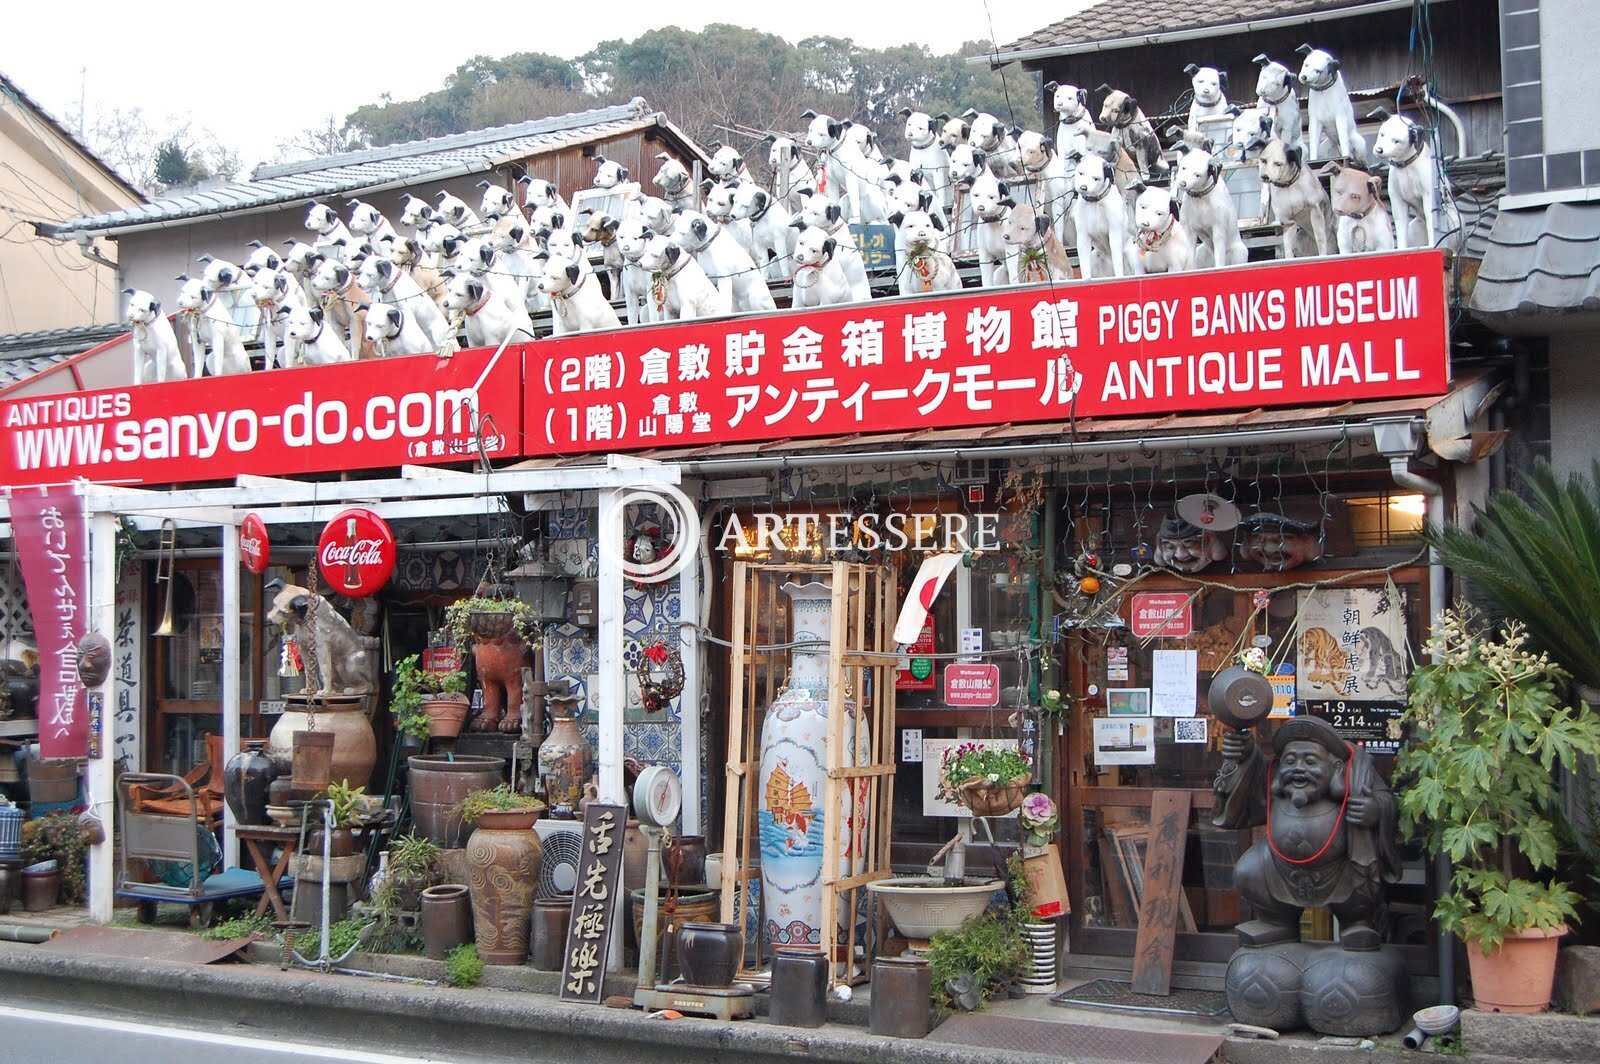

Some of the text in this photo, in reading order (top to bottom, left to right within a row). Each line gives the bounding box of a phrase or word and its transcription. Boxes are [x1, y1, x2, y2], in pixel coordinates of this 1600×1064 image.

[1098, 276, 1418, 346] PIGGY BANKS MUSEUM
[725, 357, 1082, 429] アンティークモール
[1101, 339, 1421, 402] ANTIQUE MALL
[6, 393, 131, 428] ANTIQUES
[638, 411, 712, 438] 山陽堂
[652, 391, 698, 415] 倉敷
[322, 538, 385, 567] Coca-Cola
[1341, 608, 1361, 694] 朝鮮虎展
